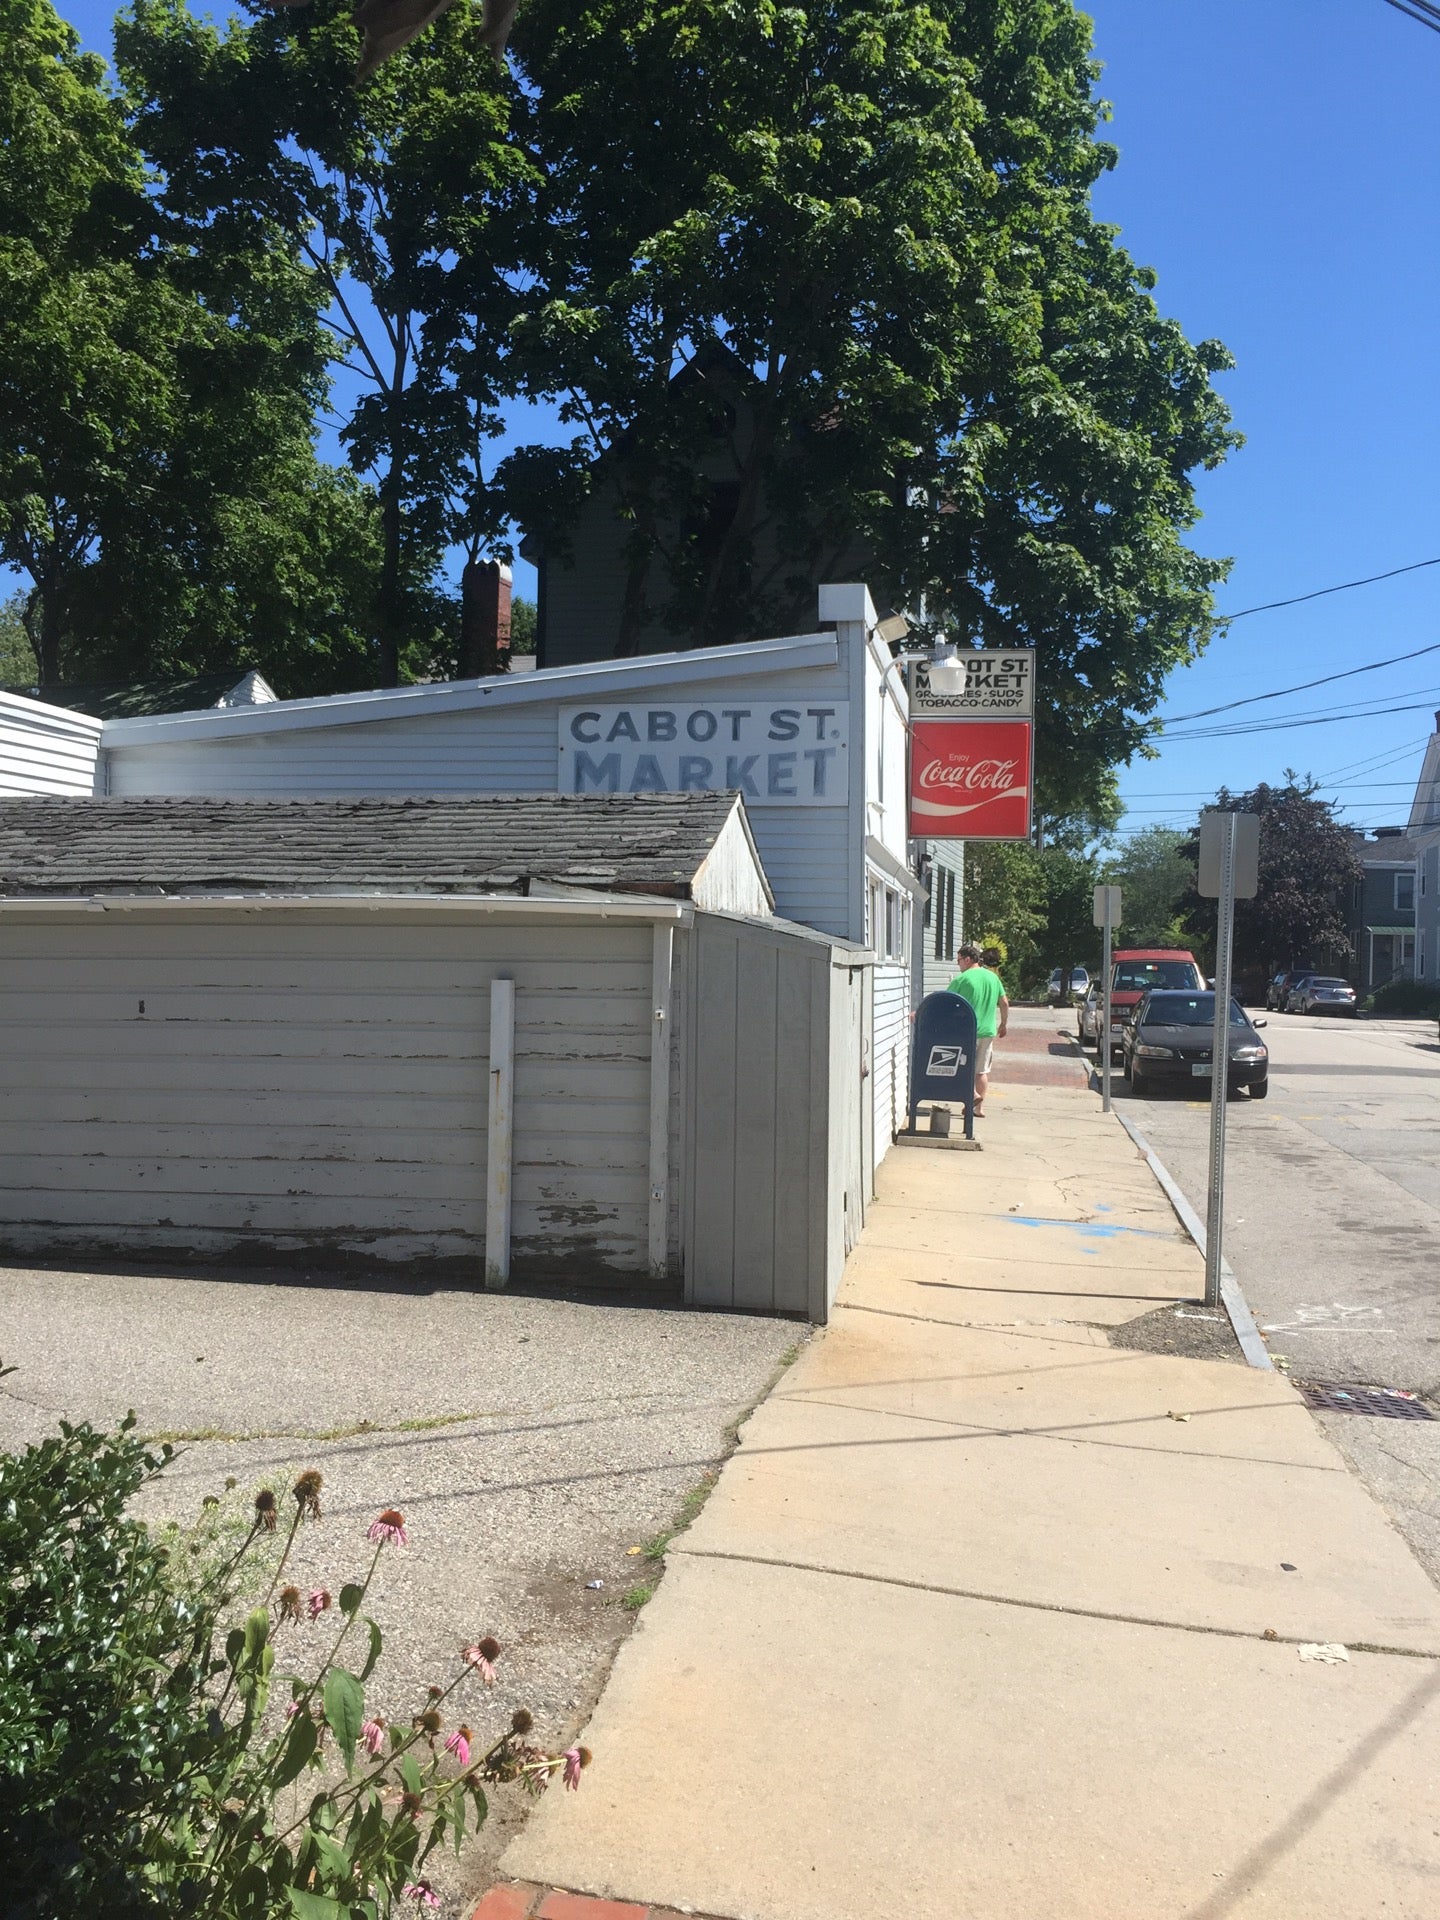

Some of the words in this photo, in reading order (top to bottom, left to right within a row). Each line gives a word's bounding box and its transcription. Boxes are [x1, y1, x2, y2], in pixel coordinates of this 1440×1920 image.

[916, 659, 996, 673] COT
[1000, 659, 1029, 673] ST.
[915, 674, 1028, 689] MKET
[915, 690, 982, 698] GRIES
[989, 690, 1024, 698] SUDS
[570, 708, 751, 743] CABOT
[948, 753, 970, 763] Enjoy
[574, 748, 836, 797] MARKET
